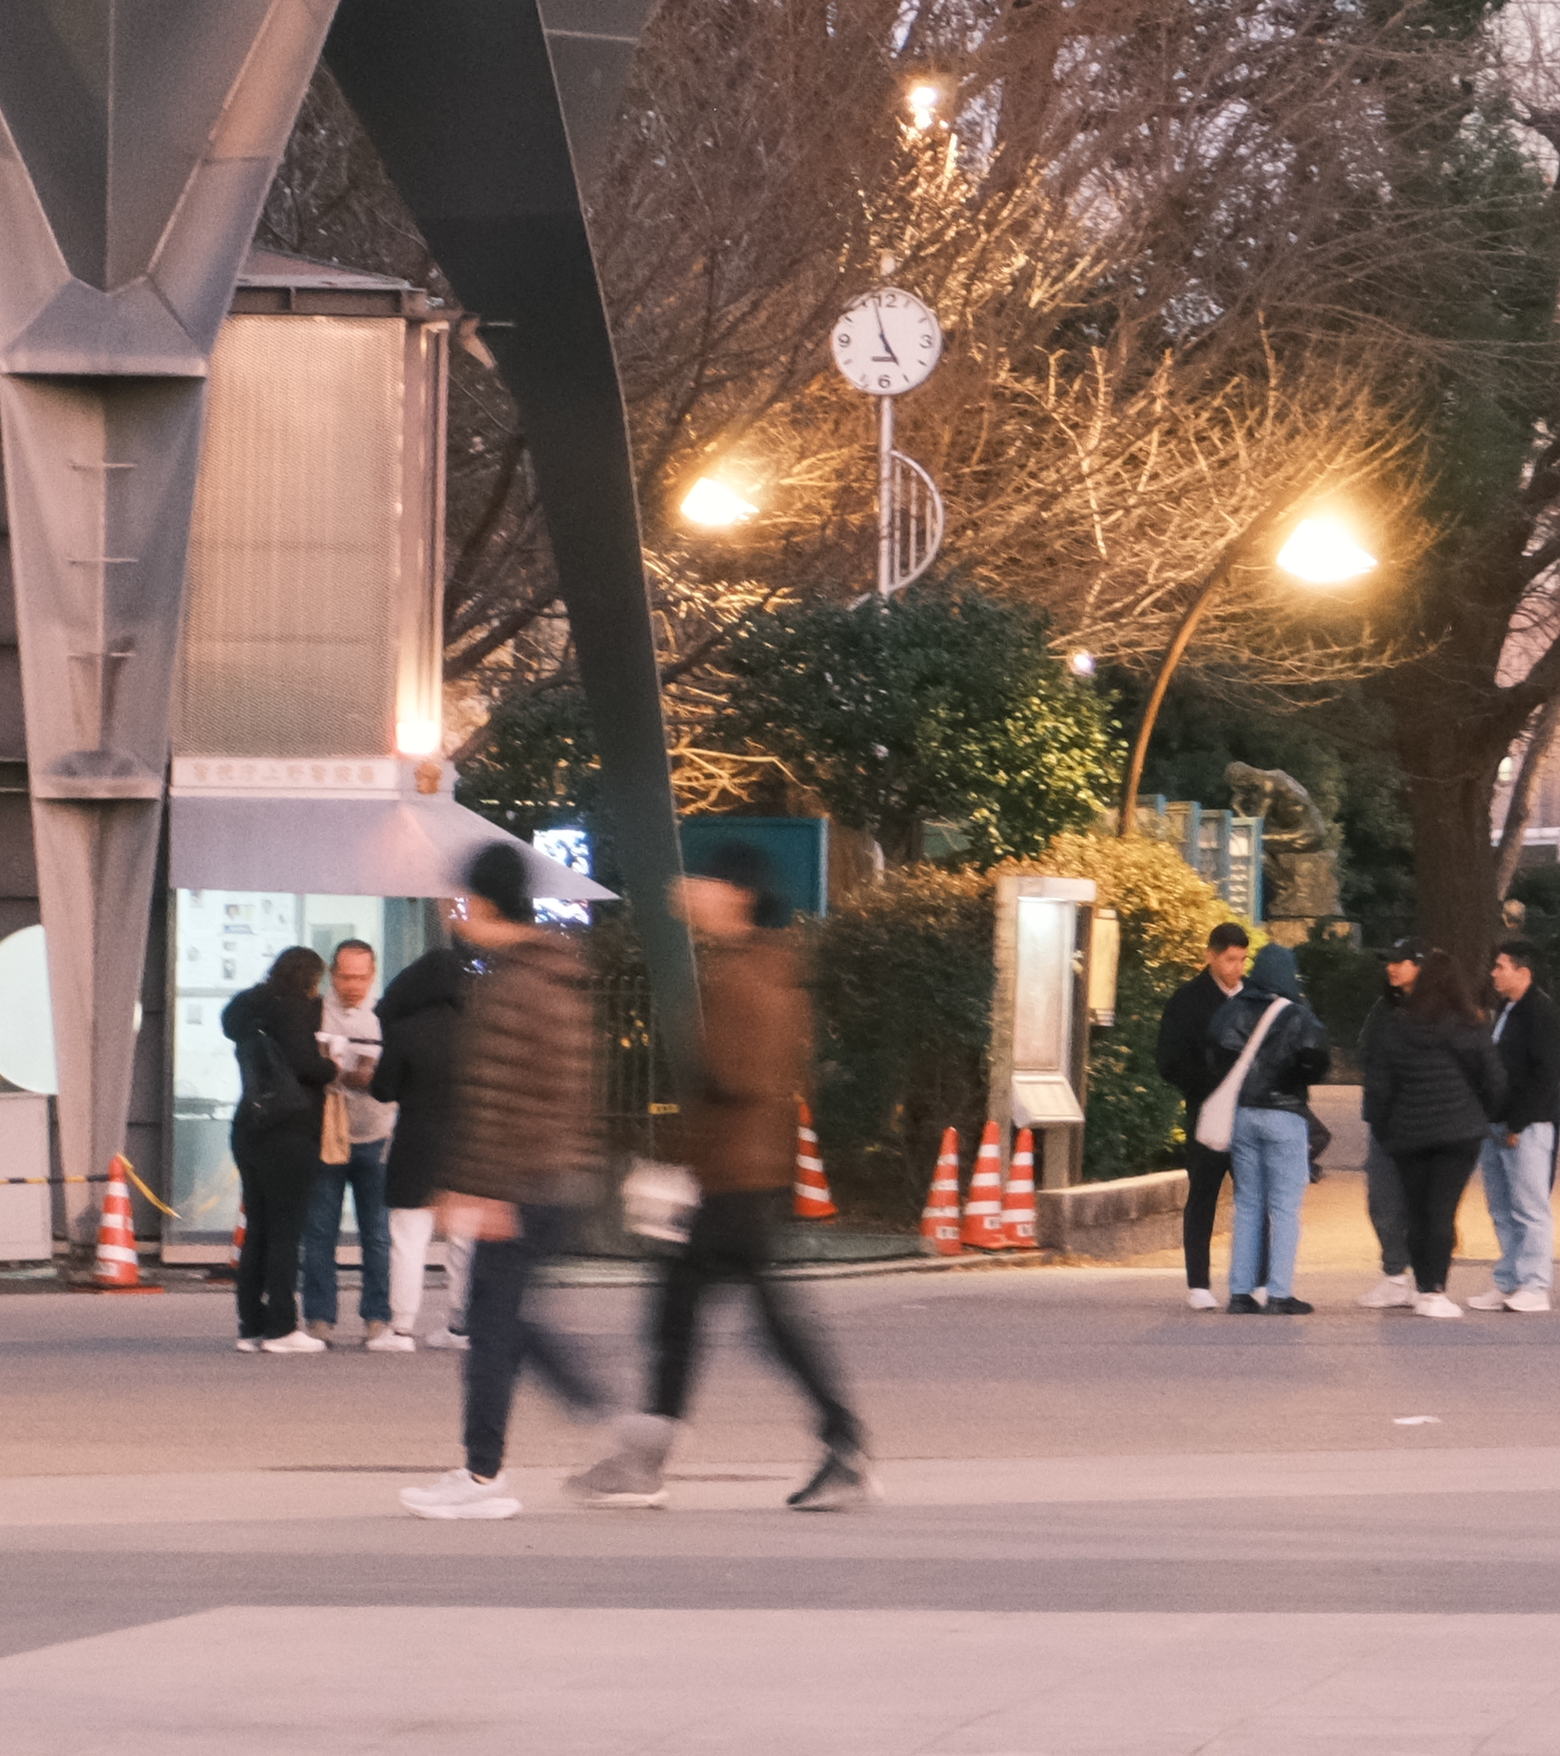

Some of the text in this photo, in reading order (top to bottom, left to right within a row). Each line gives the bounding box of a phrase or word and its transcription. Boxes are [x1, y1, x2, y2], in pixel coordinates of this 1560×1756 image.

[878, 294, 898, 308] 12
[838, 333, 851, 348] 9
[919, 334, 933, 348] 3
[878, 374, 891, 388] 6
